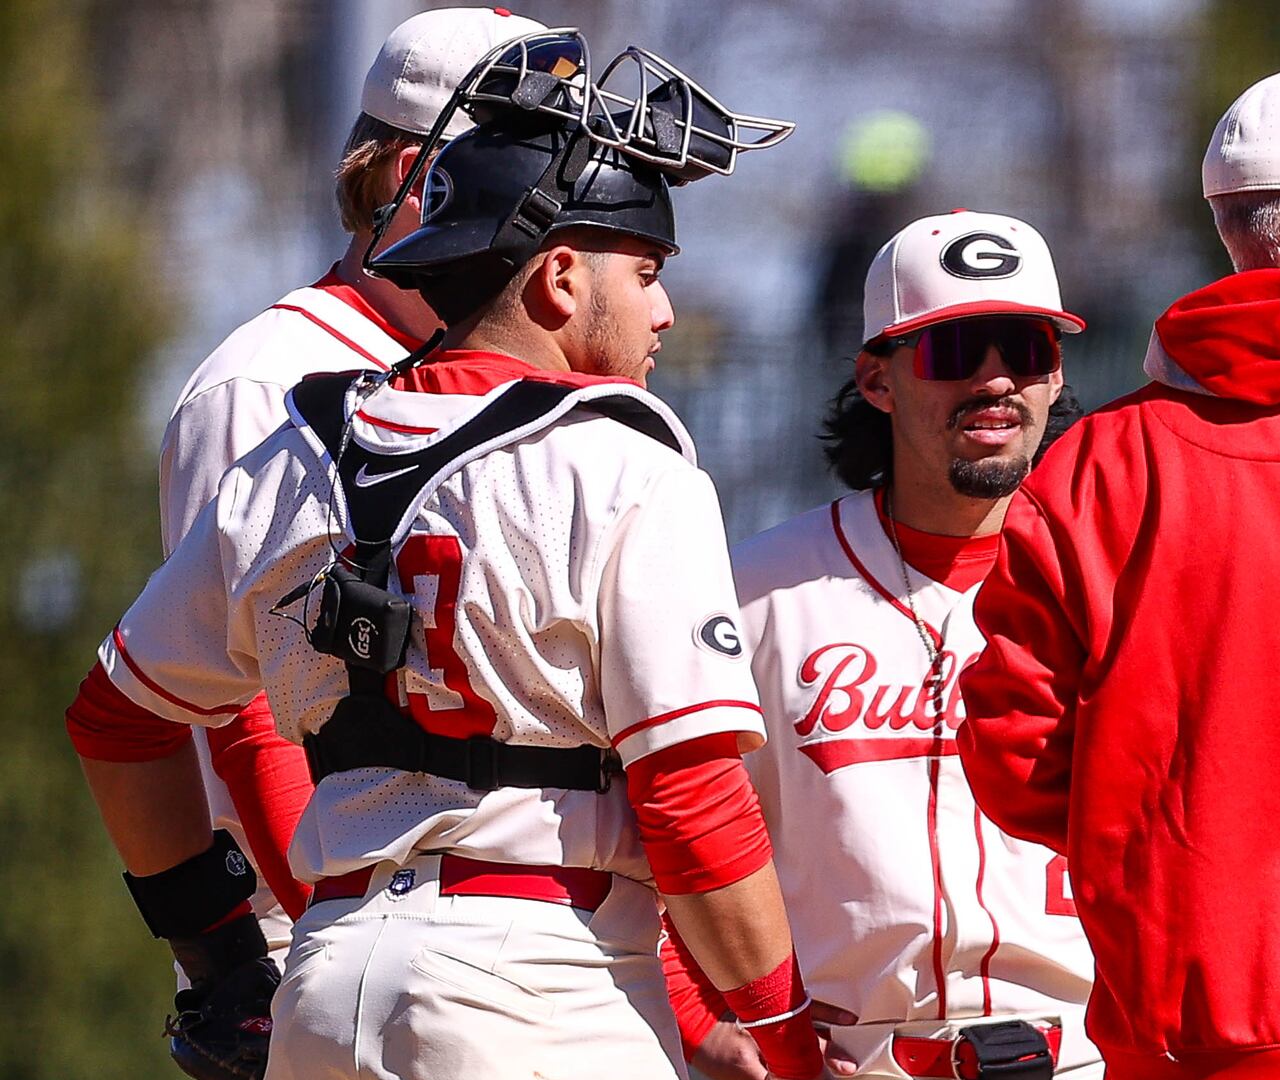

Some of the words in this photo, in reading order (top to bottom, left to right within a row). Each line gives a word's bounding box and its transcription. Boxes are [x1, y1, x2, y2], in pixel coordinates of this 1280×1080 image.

[939, 230, 1023, 281] G
[386, 534, 498, 740] 3
[699, 614, 743, 658] G
